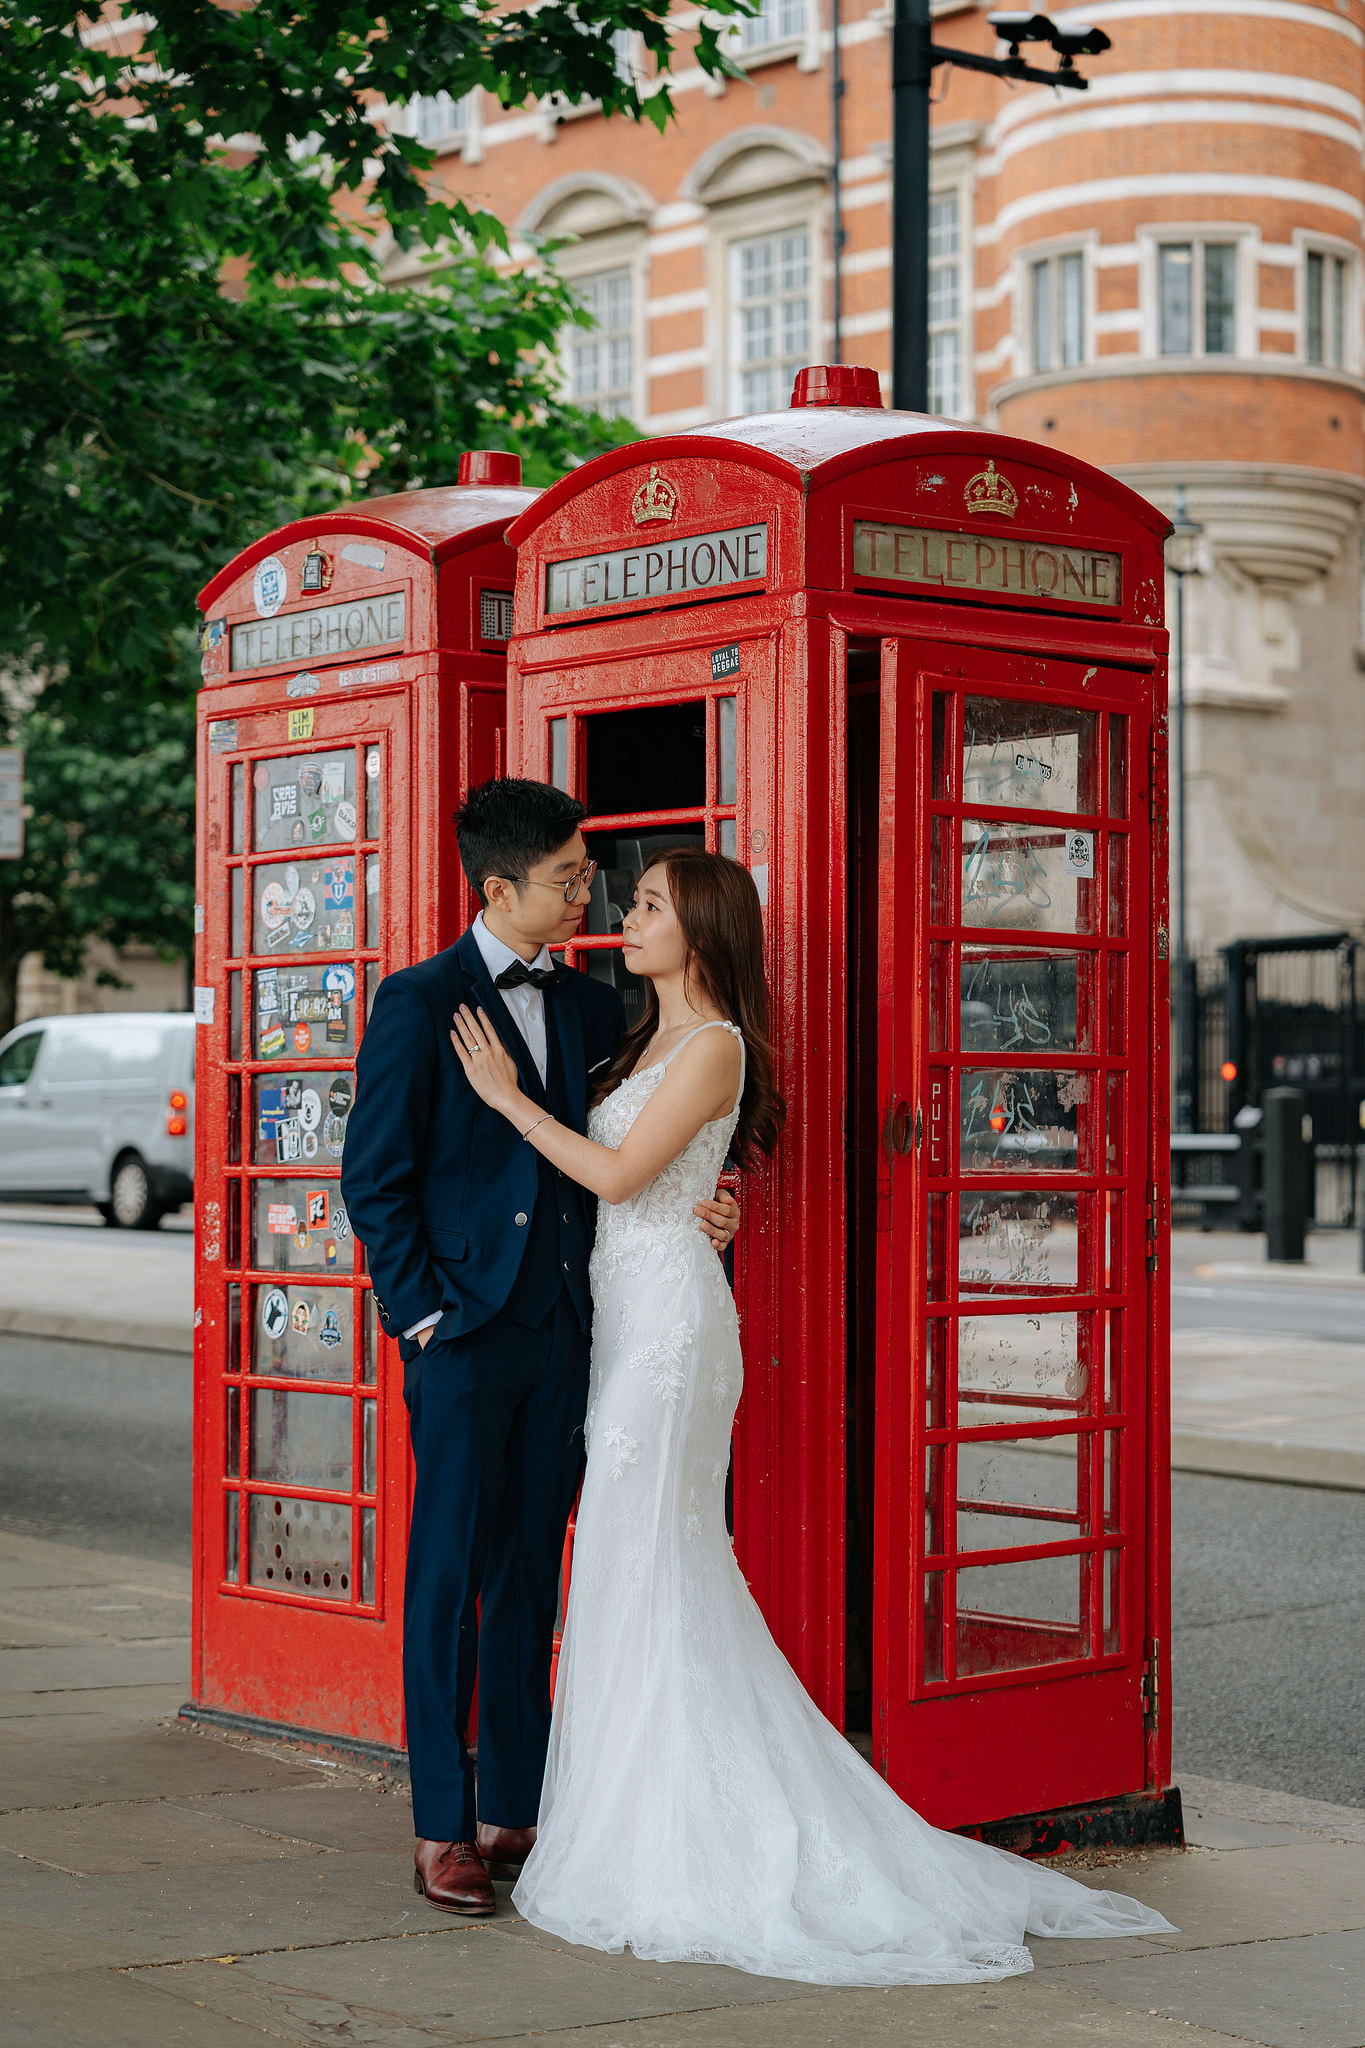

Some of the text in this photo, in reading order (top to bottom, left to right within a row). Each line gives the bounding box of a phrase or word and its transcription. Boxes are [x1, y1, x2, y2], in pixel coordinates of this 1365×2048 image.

[558, 532, 763, 609] TELEPHONE
[861, 528, 1111, 599] TELEPHONE
[240, 601, 401, 667] TELEPHONE
[711, 647, 739, 664] LOYAL TO
[712, 656, 740, 674] REGGAE
[292, 711, 309, 725] LIM
[931, 1082, 942, 1162] PULL
